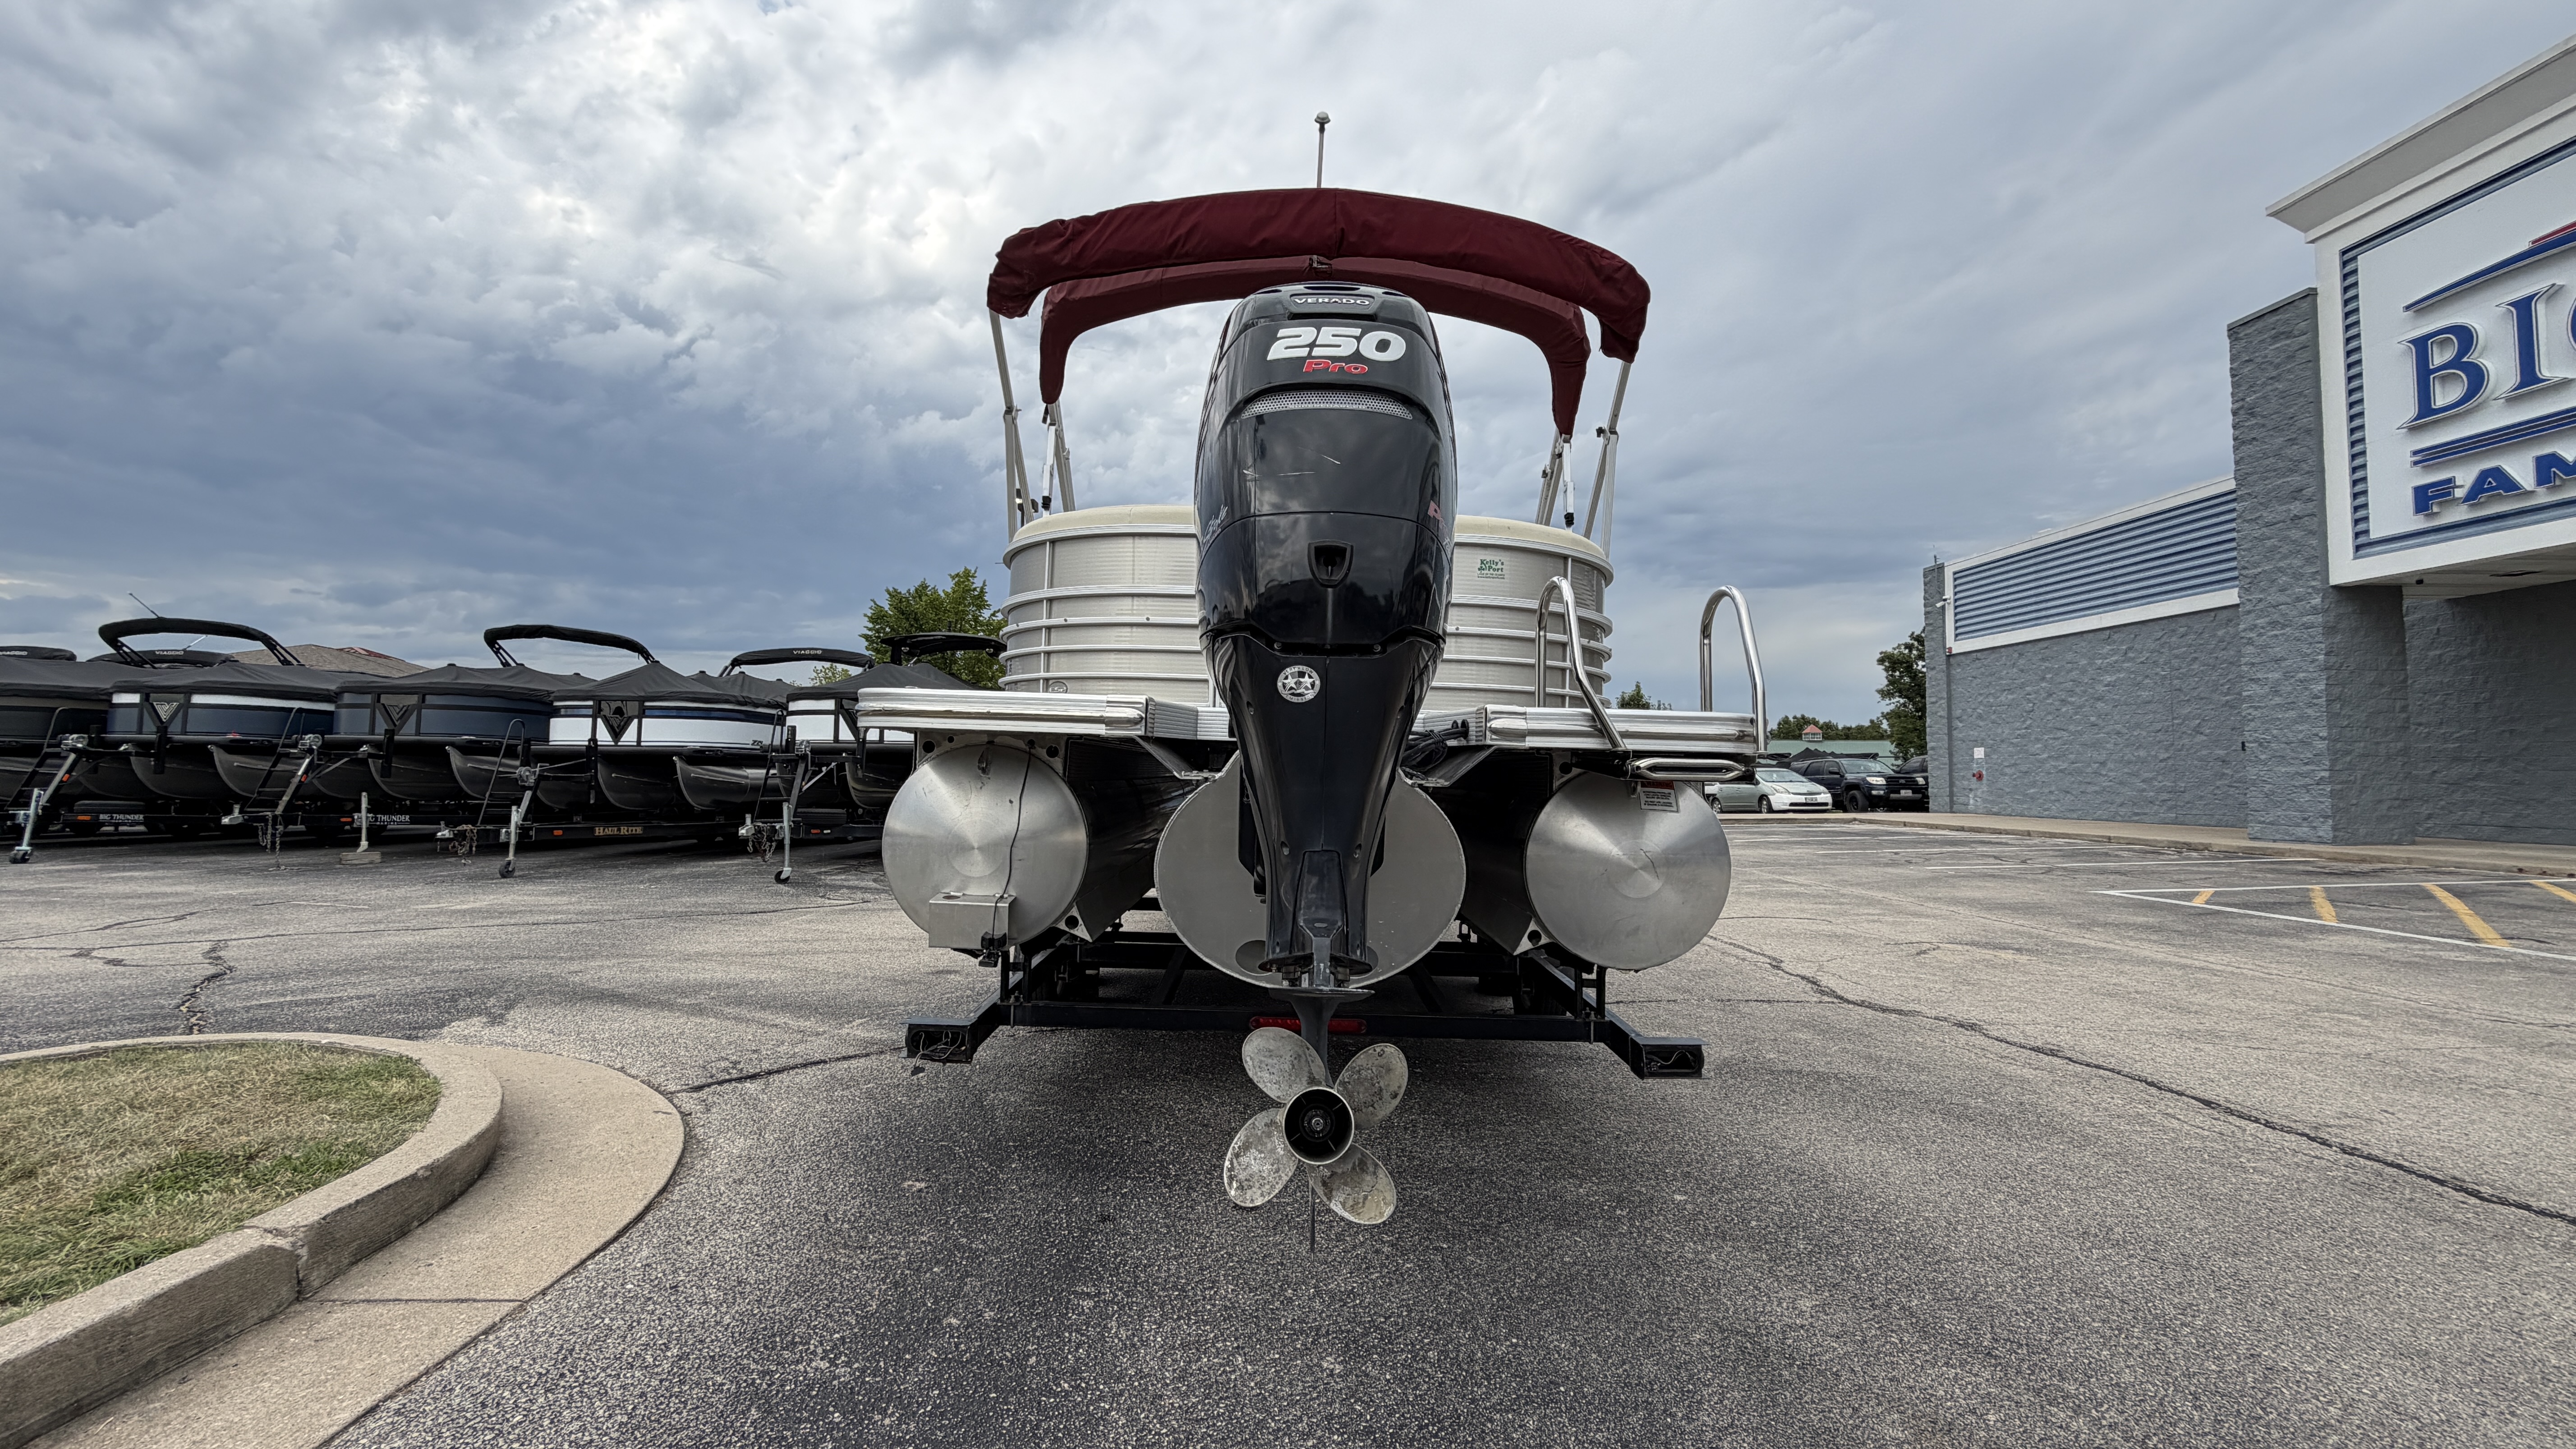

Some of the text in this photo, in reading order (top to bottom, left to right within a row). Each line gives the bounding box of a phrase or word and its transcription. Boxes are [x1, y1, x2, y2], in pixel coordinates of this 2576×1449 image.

[1267, 327, 1406, 361] 250
[2396, 283, 2576, 429] BI
[1303, 359, 1368, 374] Pro
[1480, 559, 1504, 567] Kelly's
[1283, 667, 1296, 675] VERY
[594, 826, 644, 835] HAUL RITE
